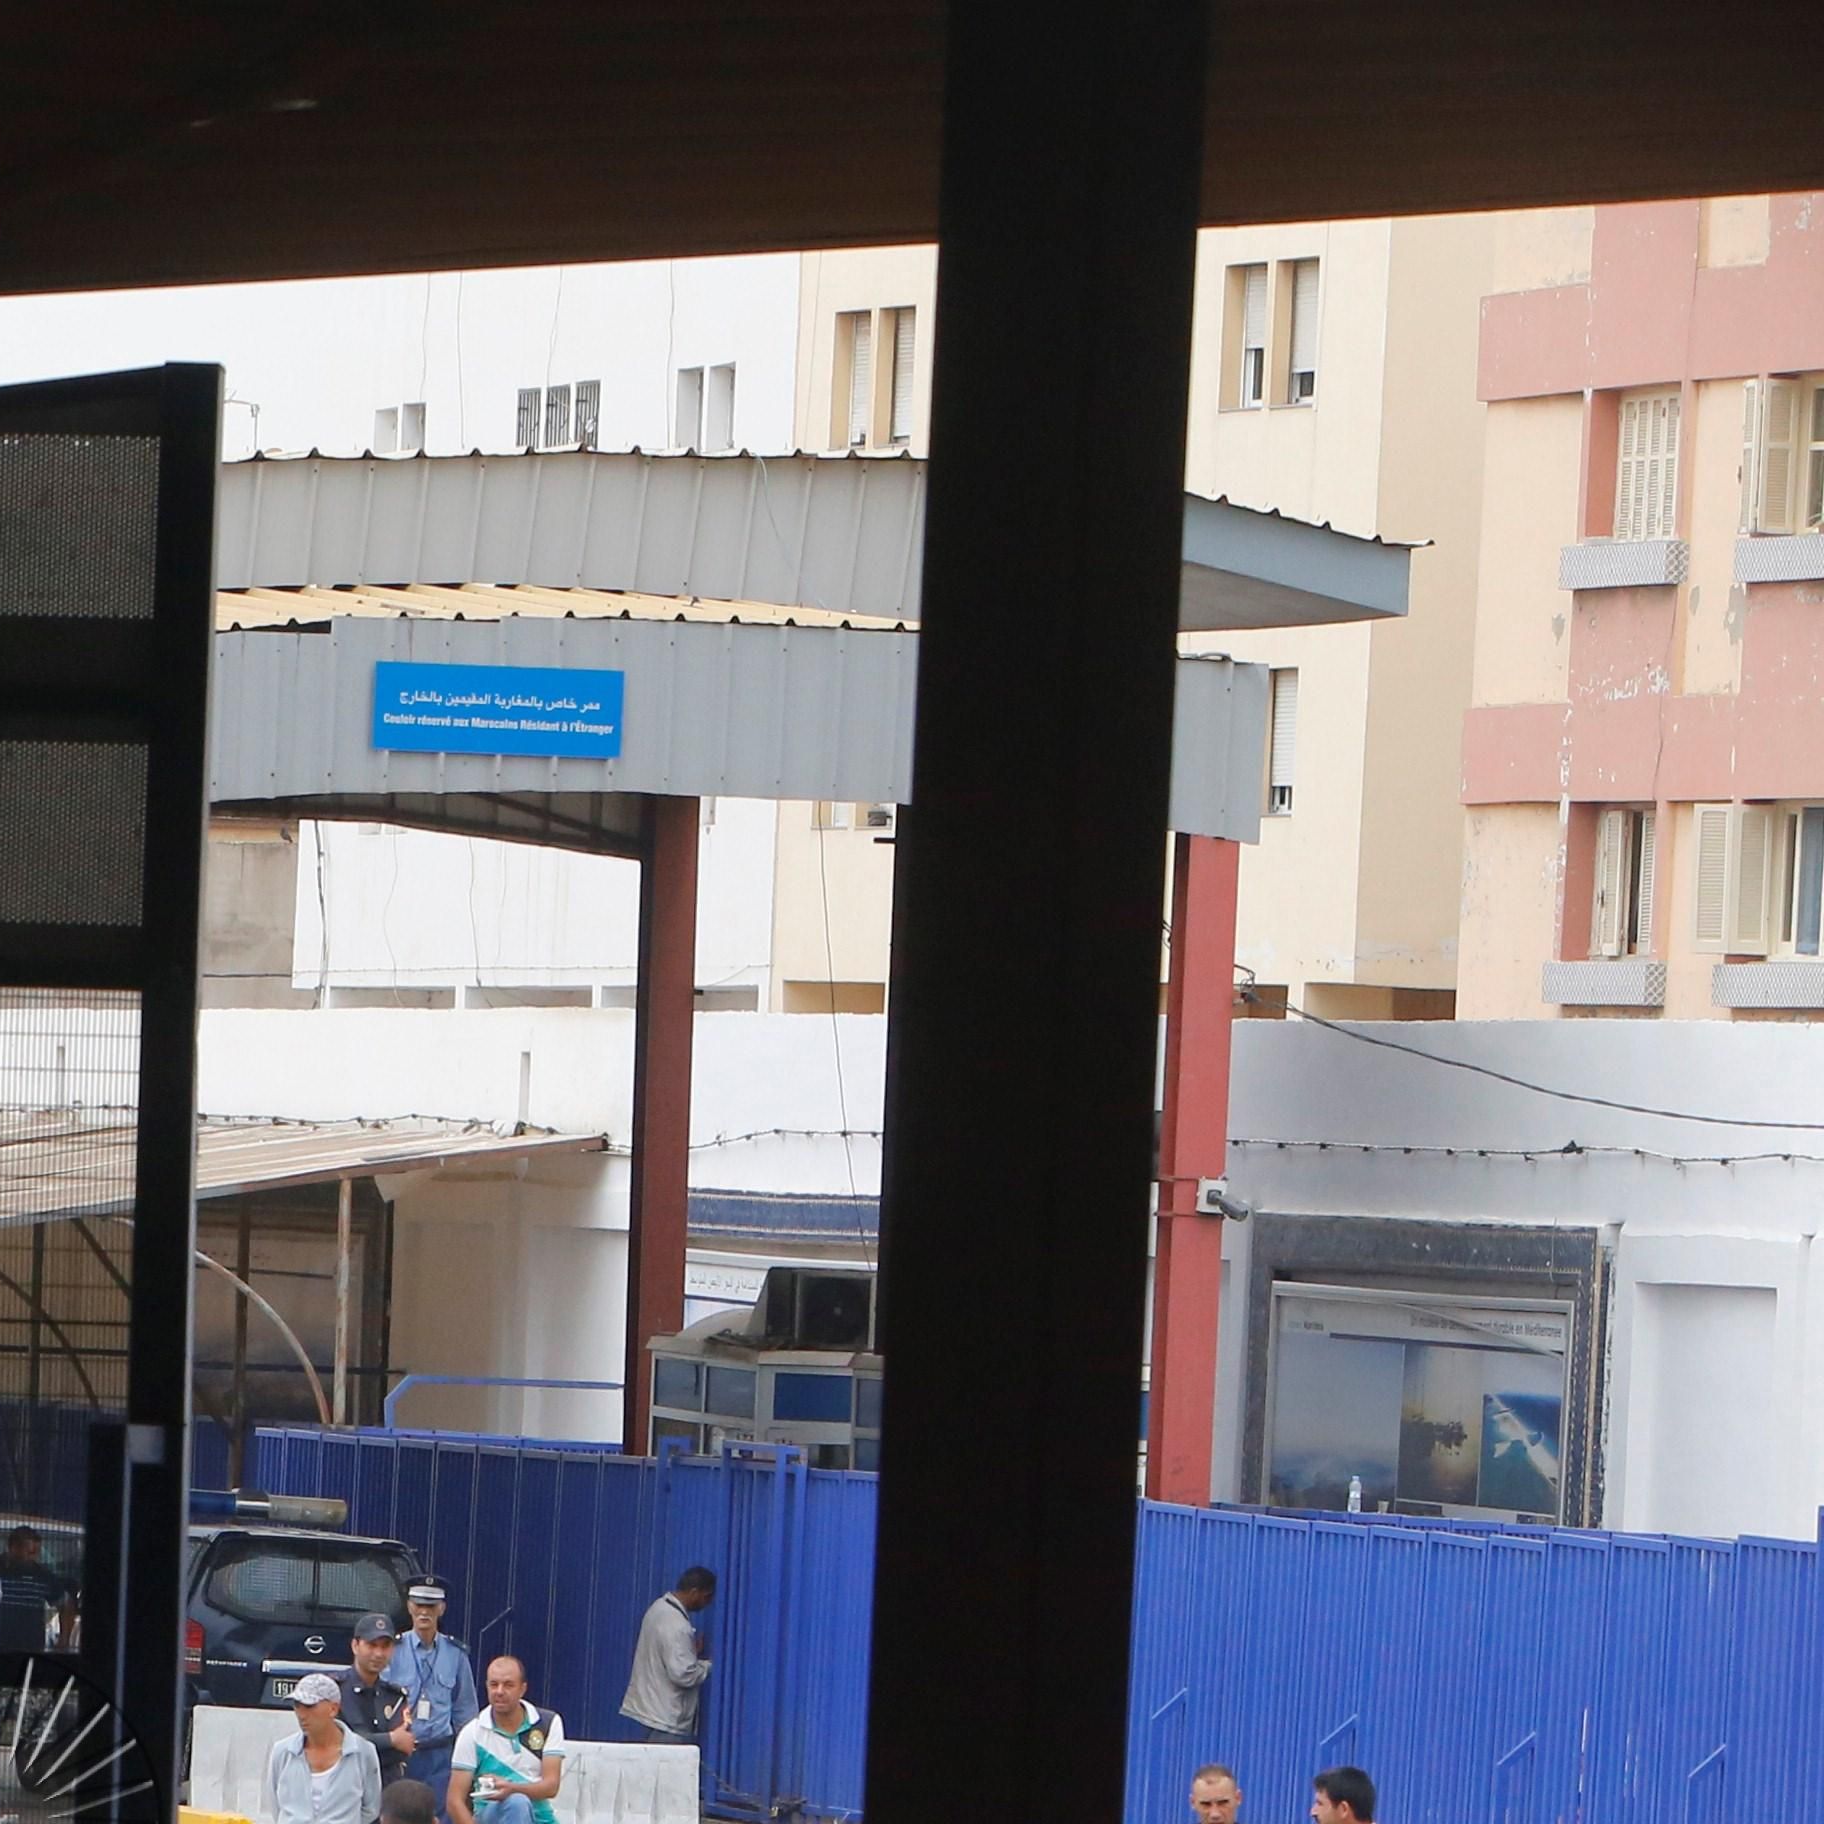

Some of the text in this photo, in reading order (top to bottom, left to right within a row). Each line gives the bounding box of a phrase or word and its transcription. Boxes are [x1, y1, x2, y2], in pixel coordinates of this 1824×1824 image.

[399, 690, 442, 706] بالخارج
[445, 691, 491, 707] المقيمين
[545, 698, 577, 711] خاص
